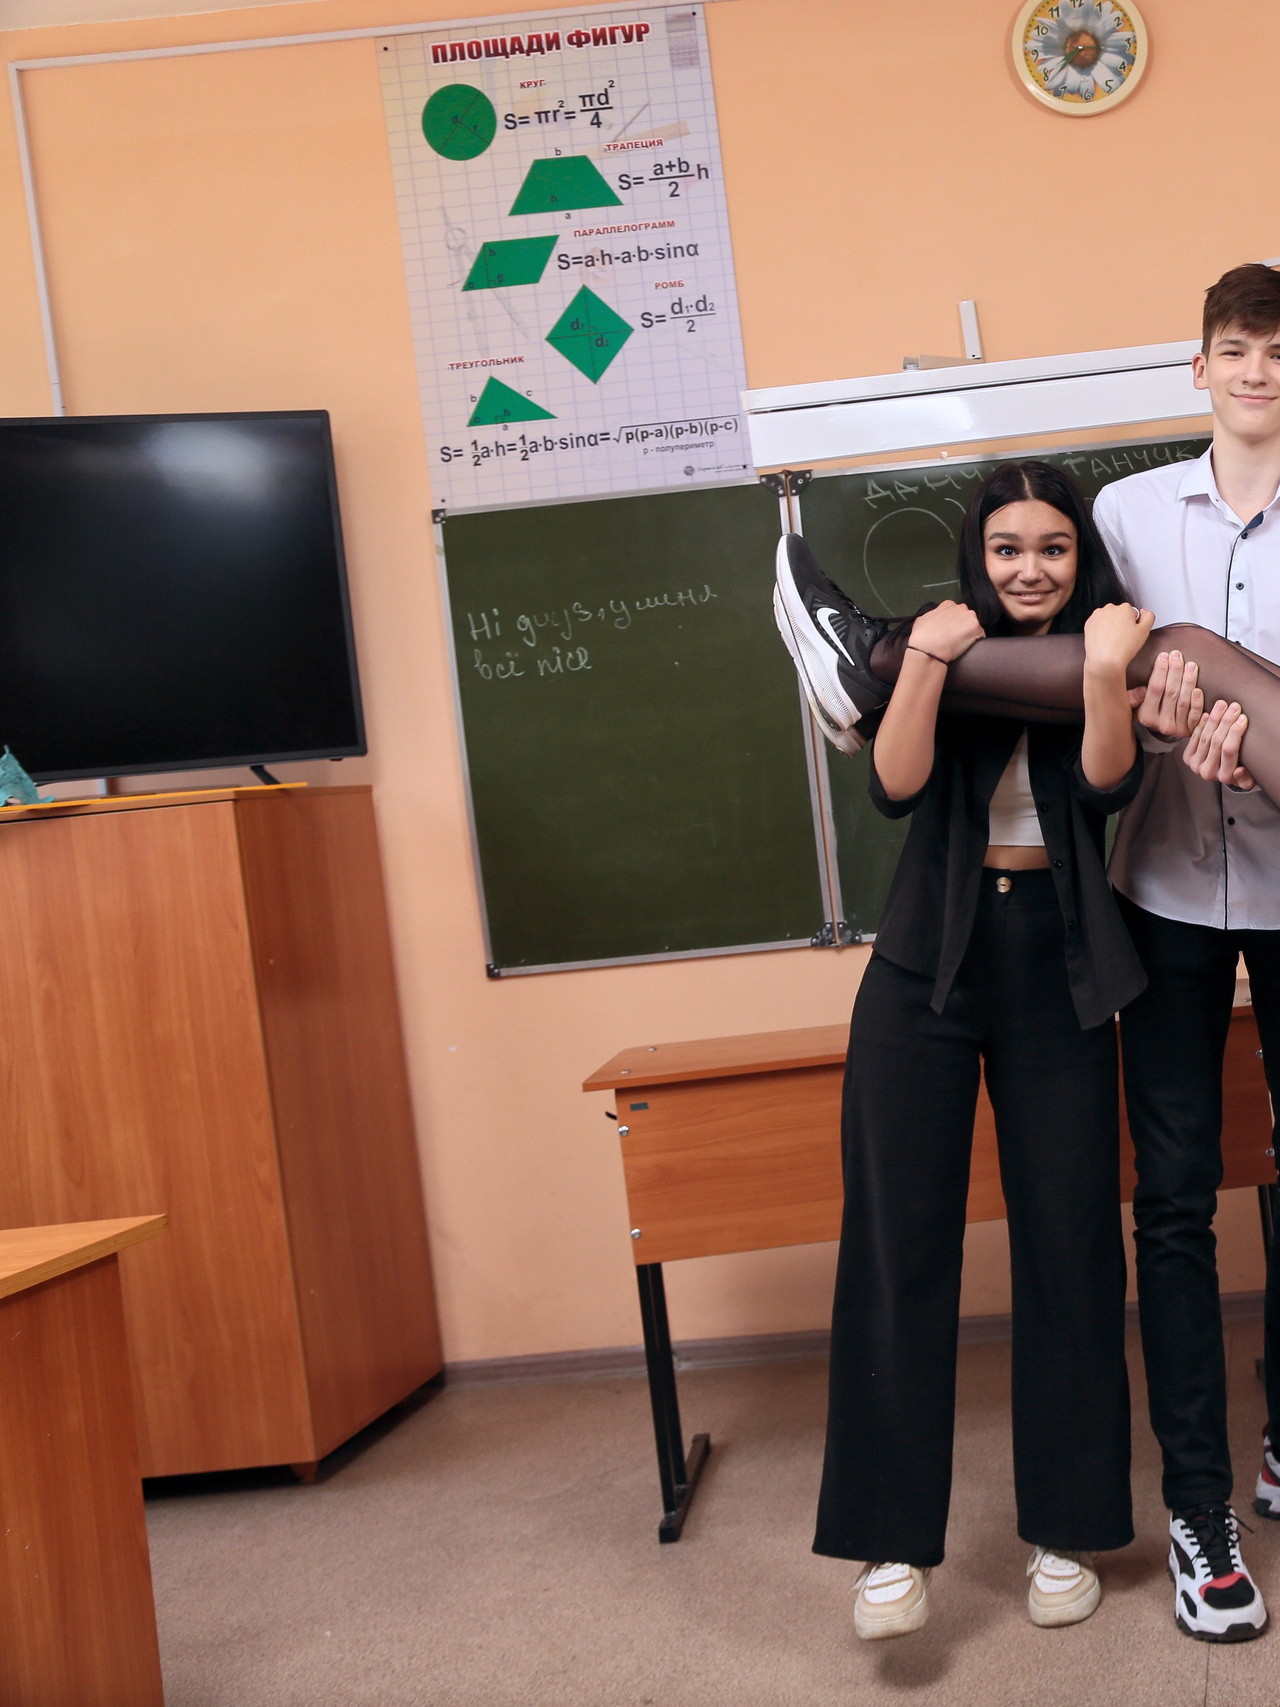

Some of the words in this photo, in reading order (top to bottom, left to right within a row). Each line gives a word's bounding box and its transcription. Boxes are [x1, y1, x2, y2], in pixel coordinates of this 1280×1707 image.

[1048, 7, 1060, 18] 11
[1097, 3, 1102, 13] 1
[1114, 17, 1122, 27] 2
[1035, 25, 1048, 35] 10
[432, 32, 560, 63] ПЛОЩАДИ
[567, 23, 649, 49] ФИГУР
[1125, 38, 1131, 51] 3
[1031, 50, 1039, 63] 9
[1119, 61, 1126, 72] 4
[1043, 68, 1049, 81] 8
[520, 80, 545, 89] КРУГ
[1105, 79, 1114, 93] 5
[1060, 86, 1067, 99] 7
[1083, 88, 1092, 100] 6
[590, 113, 602, 129] 4
[606, 139, 663, 152] ТРАПЕЦИЯ
[669, 182, 680, 197] 2
[574, 221, 675, 237] ПАРАЛЛЕЛОГРАММ
[655, 280, 684, 289] РОМБ
[686, 320, 696, 333] 2
[449, 356, 524, 371] ТРЕУГОЛЬНИК
[467, 608, 501, 641] Hi
